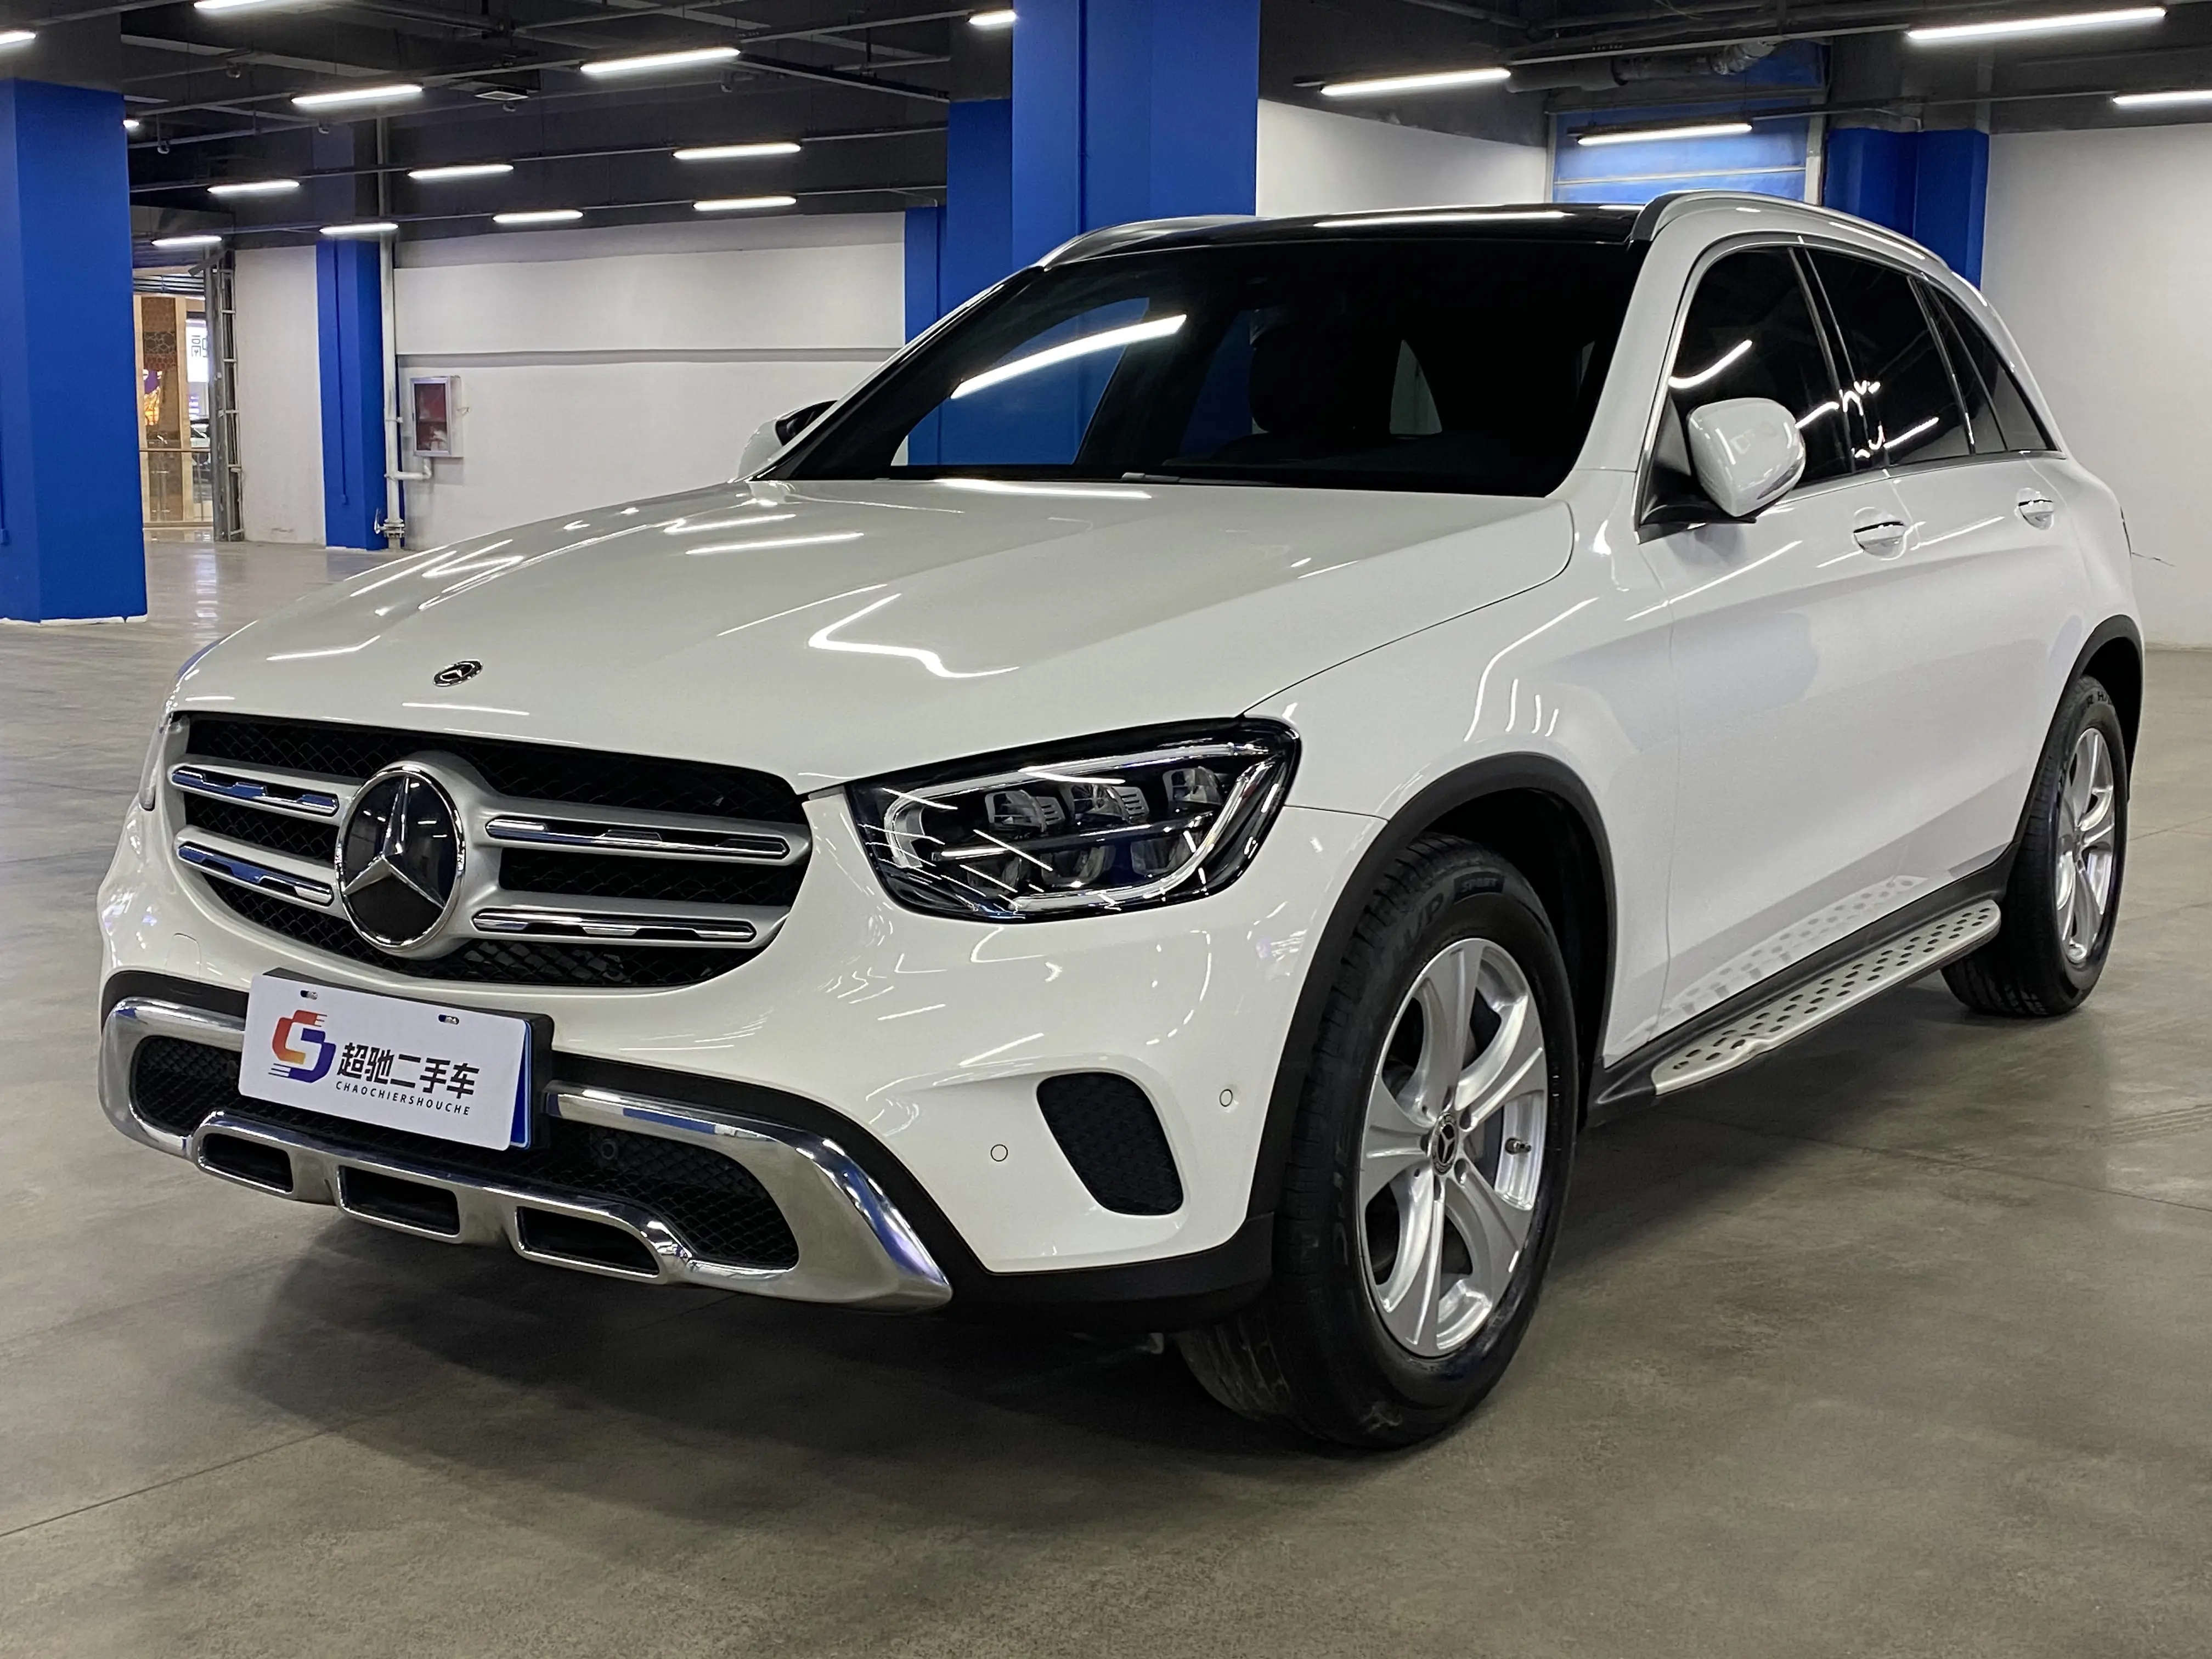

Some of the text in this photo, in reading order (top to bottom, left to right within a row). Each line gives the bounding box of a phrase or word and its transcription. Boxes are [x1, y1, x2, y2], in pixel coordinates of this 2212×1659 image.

[336, 1042, 479, 1099] 超驰二手车
[336, 1081, 470, 1115] CHAOCHIERSHOUCHE
